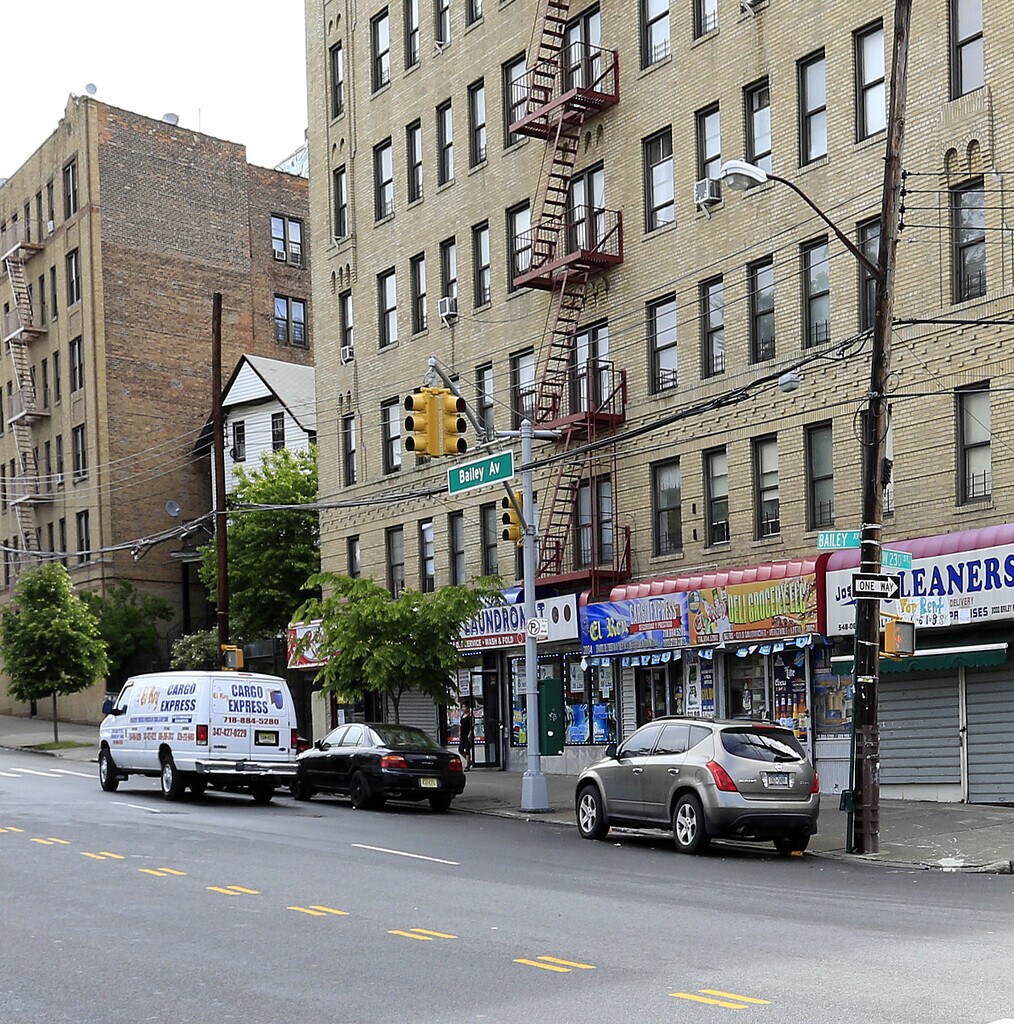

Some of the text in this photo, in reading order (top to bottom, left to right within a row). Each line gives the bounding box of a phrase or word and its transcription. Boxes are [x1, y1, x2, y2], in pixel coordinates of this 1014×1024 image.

[459, 461, 500, 484] Bailey Av
[820, 532, 848, 547] BAILEY
[890, 553, 902, 566] 230
[860, 581, 894, 591] ONE WAY
[728, 594, 746, 624] DELI
[748, 582, 788, 623] GROCERY
[900, 597, 944, 615] For Rent
[950, 596, 974, 608] DELIVERY
[464, 602, 545, 636] LAUNDROT
[630, 600, 677, 624] CARGO EXPRESS
[950, 606, 988, 621] PRISES
[590, 620, 602, 642] El
[606, 617, 629, 638] Rey
[838, 622, 856, 631] 548-0
[484, 637, 498, 646] WASH
[498, 636, 502, 644] &
[502, 636, 514, 644] FOLD
[167, 684, 196, 696] CARGO
[232, 684, 263, 698] CARGO
[160, 699, 196, 712] EXPRESS
[228, 700, 268, 714] EXPRESS
[224, 716, 279, 725] 718-884-5280
